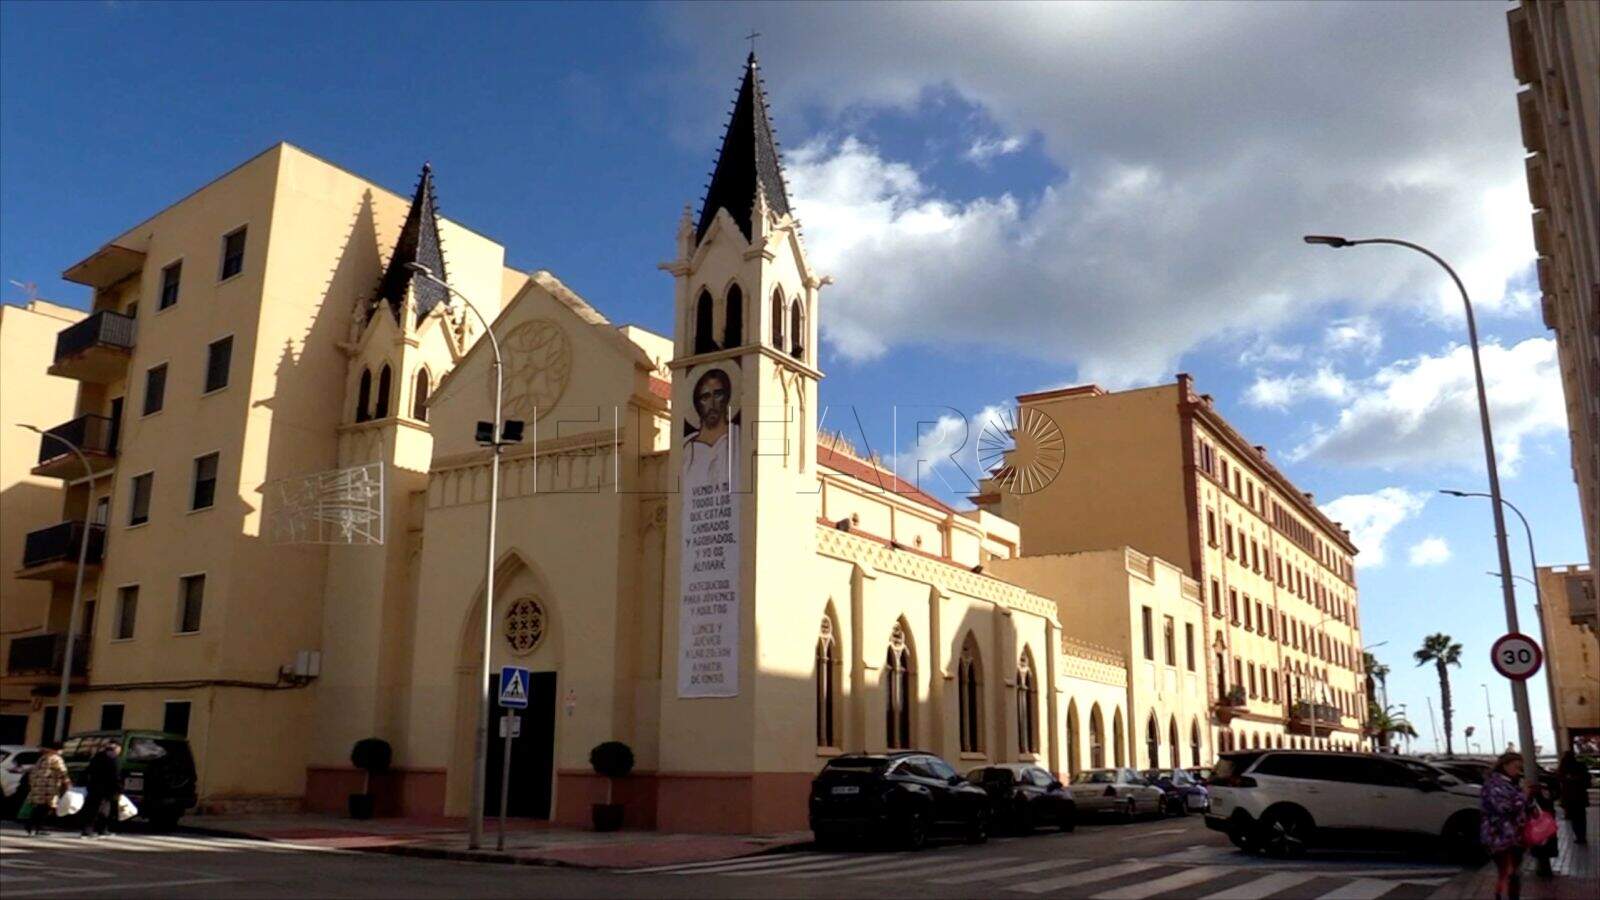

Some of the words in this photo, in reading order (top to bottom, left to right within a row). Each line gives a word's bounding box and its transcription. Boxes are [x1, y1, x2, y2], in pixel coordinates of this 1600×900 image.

[714, 483, 720, 494] A
[692, 496, 713, 509] TODOS
[716, 494, 730, 505] LOS
[690, 511, 702, 522] QUE
[702, 547, 711, 558] YO
[713, 546, 724, 557] OS
[1502, 648, 1531, 665] 30
